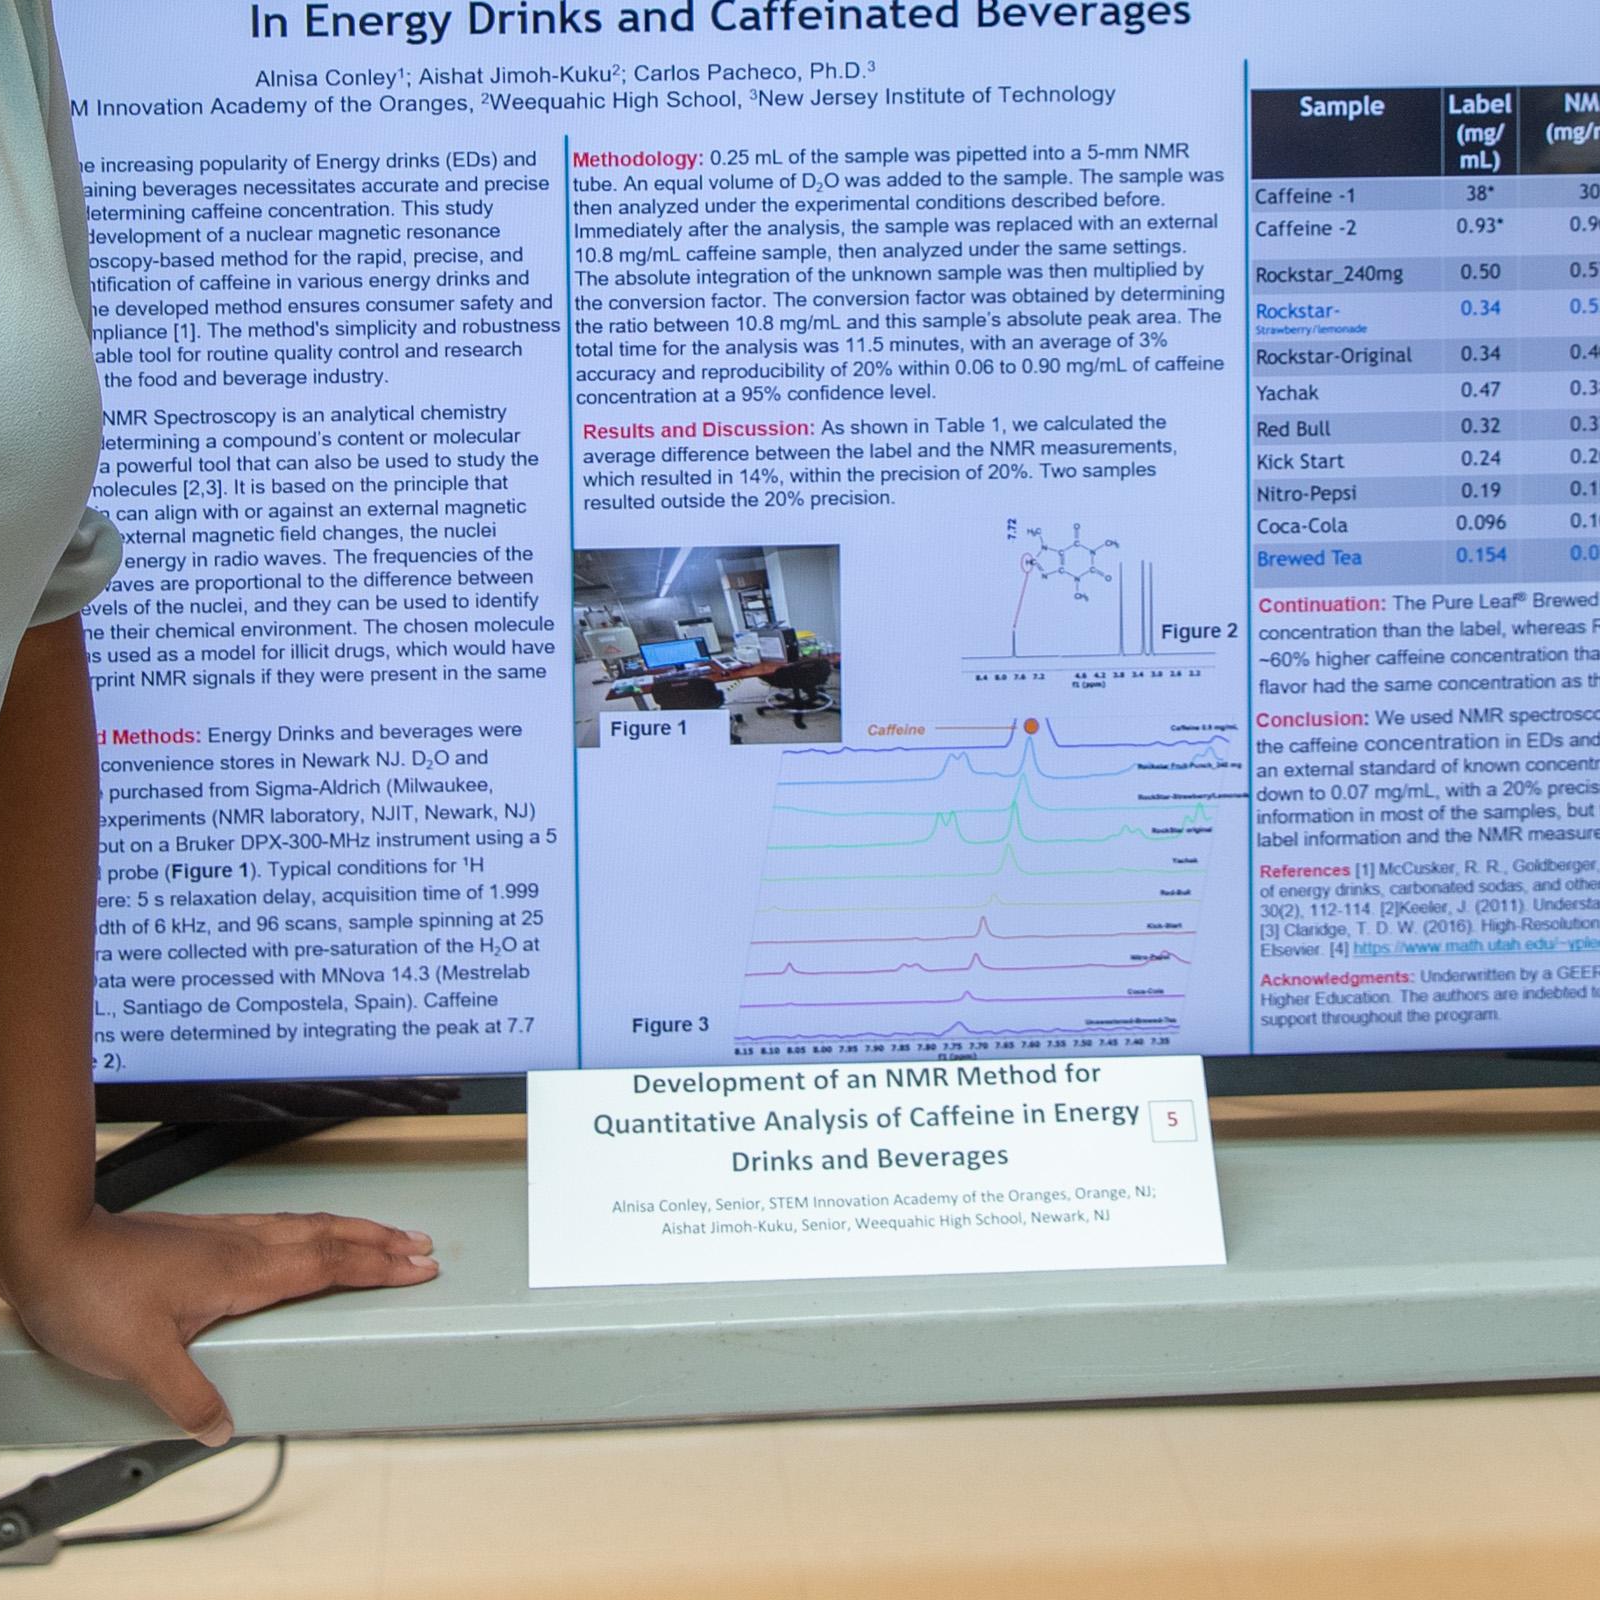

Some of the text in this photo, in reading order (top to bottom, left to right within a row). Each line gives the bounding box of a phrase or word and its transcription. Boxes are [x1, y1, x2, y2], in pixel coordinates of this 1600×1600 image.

[252, 4, 287, 37] In
[306, 3, 451, 45] Energy
[470, 0, 601, 34] Drinks
[256, 70, 317, 87] Alnisa
[419, 68, 482, 85] Aishat
[634, 65, 699, 82] Carlos
[708, 64, 802, 84] Pacheco,
[98, 98, 202, 115] Innovation
[210, 97, 306, 118] Academy
[315, 96, 333, 112] of
[341, 96, 371, 112] the
[380, 95, 473, 116] Oranges,
[614, 92, 657, 113] High
[667, 91, 742, 110] School,
[811, 89, 877, 109] Jersey
[886, 88, 964, 105] Institute
[973, 87, 991, 103] of
[998, 85, 1115, 106] Technology
[1299, 95, 1385, 120] Sample
[1449, 92, 1512, 114] Label
[1456, 123, 1505, 147] (mg/
[101, 154, 311, 176] increasing popularity of
[574, 150, 703, 170] Methodology:
[1460, 148, 1500, 173] mL)
[1255, 188, 1331, 205] Caffeine
[1580, 183, 1600, 199] 30
[1255, 220, 1331, 237] Caffeine
[1256, 264, 1403, 285] Rockstar_240mg
[1461, 263, 1500, 280] 0.50
[1257, 346, 1412, 367] Rockstar-Original
[1461, 345, 1500, 362] 0.34
[584, 419, 815, 439] Results and Discussion:
[1257, 421, 1289, 437] Red
[1297, 420, 1330, 436] Bull
[1461, 417, 1500, 434] 0.32
[1257, 517, 1348, 534] Coca-Cola
[1456, 514, 1506, 531] 0.096
[1258, 550, 1324, 567] Brewed
[1331, 549, 1362, 566] Tea
[1457, 547, 1506, 563] 0.154
[1259, 594, 1386, 614] Continuation:
[1162, 622, 1238, 642] Figure 2
[611, 720, 687, 740] Figure 1
[868, 722, 925, 737] Caffeine
[1257, 710, 1369, 729] Conclusion:
[113, 728, 201, 745] Methods:
[1260, 861, 1350, 879] References
[1260, 967, 1416, 988] Acknowledgments:
[633, 1016, 709, 1036] Figure 3
[634, 1061, 1101, 1097] Development of an NMR Method for
[594, 1100, 1140, 1137] Quantitative Analysis of Caffeine in Energy
[1168, 1111, 1178, 1127] 5
[732, 1145, 1008, 1172] Drinks and Beverages
[613, 1185, 1156, 1214] Alnisa Conley, Senior, STEM Innovation Academy of the Oranges, Orange, NJ;
[662, 1209, 1110, 1235] Aishat Jimoh-Kuku, Senior, Weequahic High School, Newark, NJ
